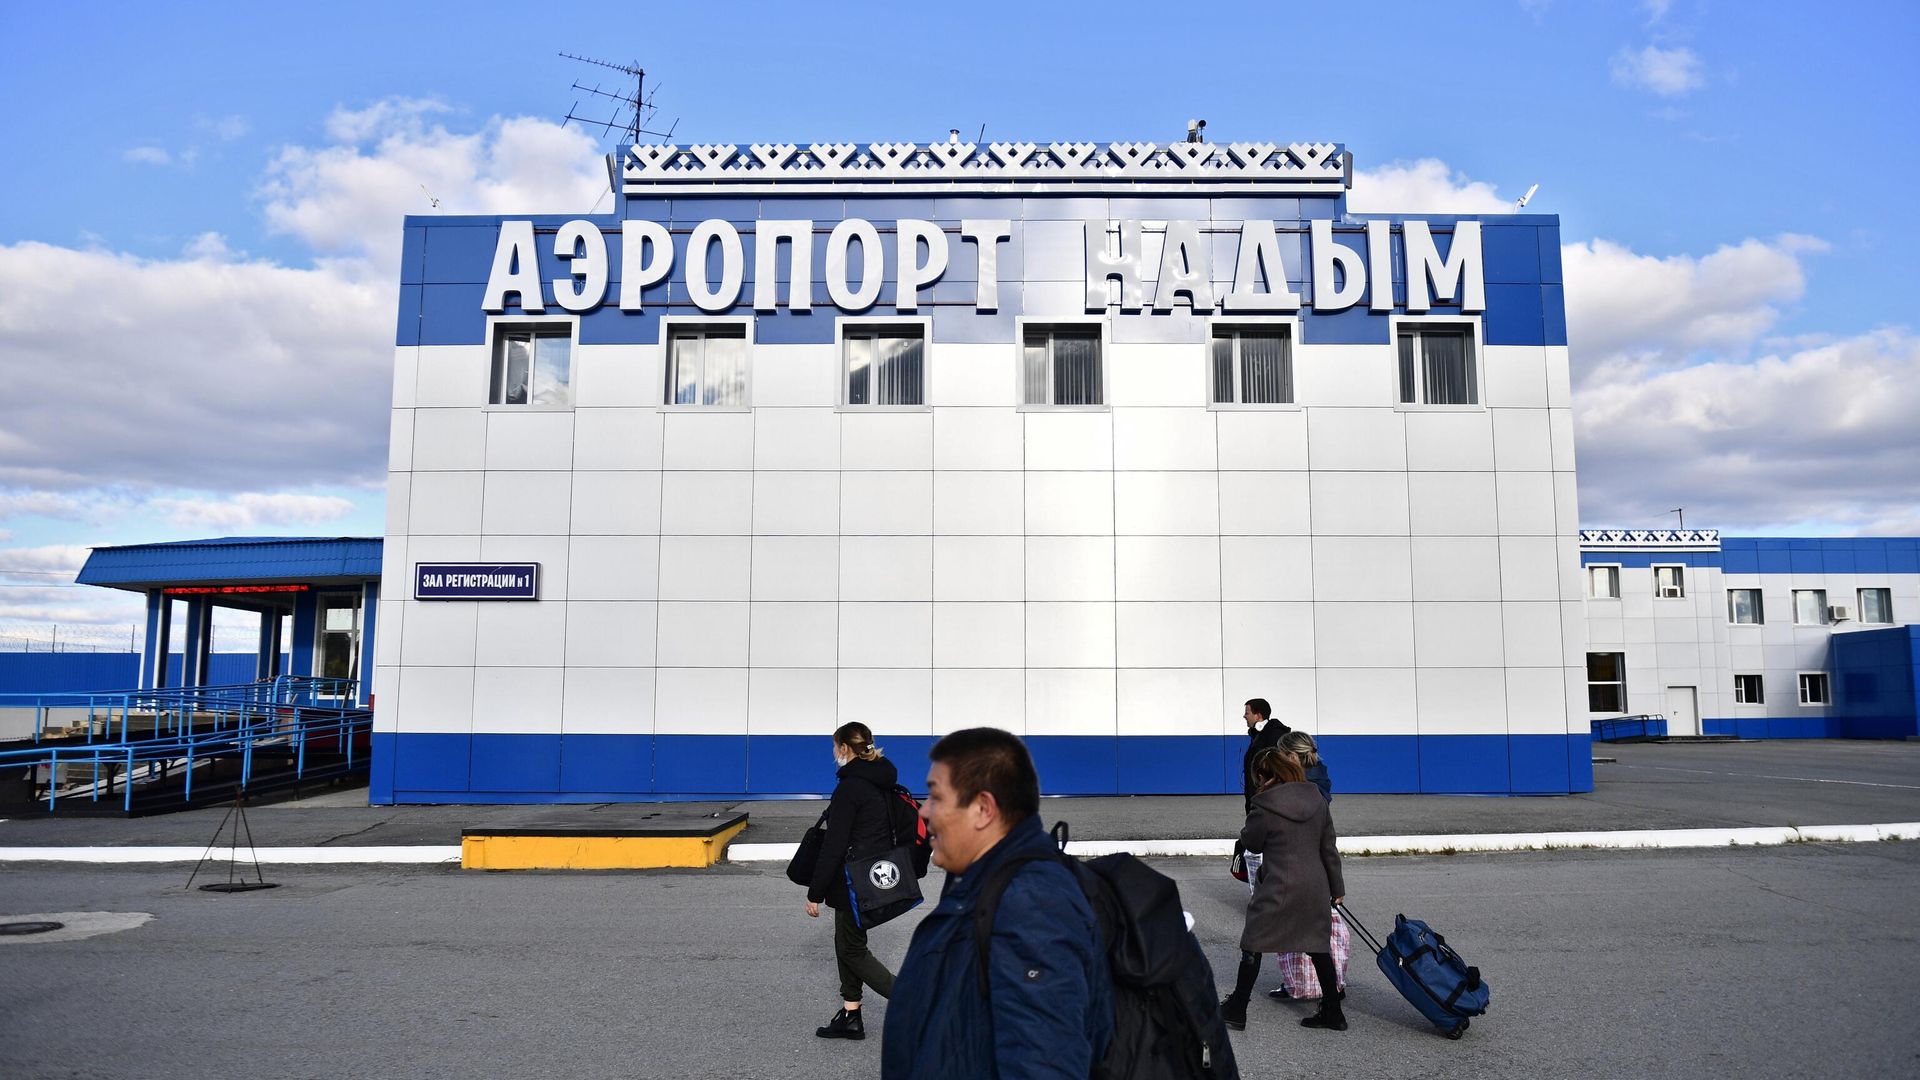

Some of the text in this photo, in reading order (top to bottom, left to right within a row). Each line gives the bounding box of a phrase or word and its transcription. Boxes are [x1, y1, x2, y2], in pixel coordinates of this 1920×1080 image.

[481, 219, 1486, 315] АЭРОПОРТ НАДЫМ
[422, 574, 443, 588] ЗАЛ
[445, 574, 516, 589] РЕГИСТРАЦИИ
[524, 574, 530, 588] 1
